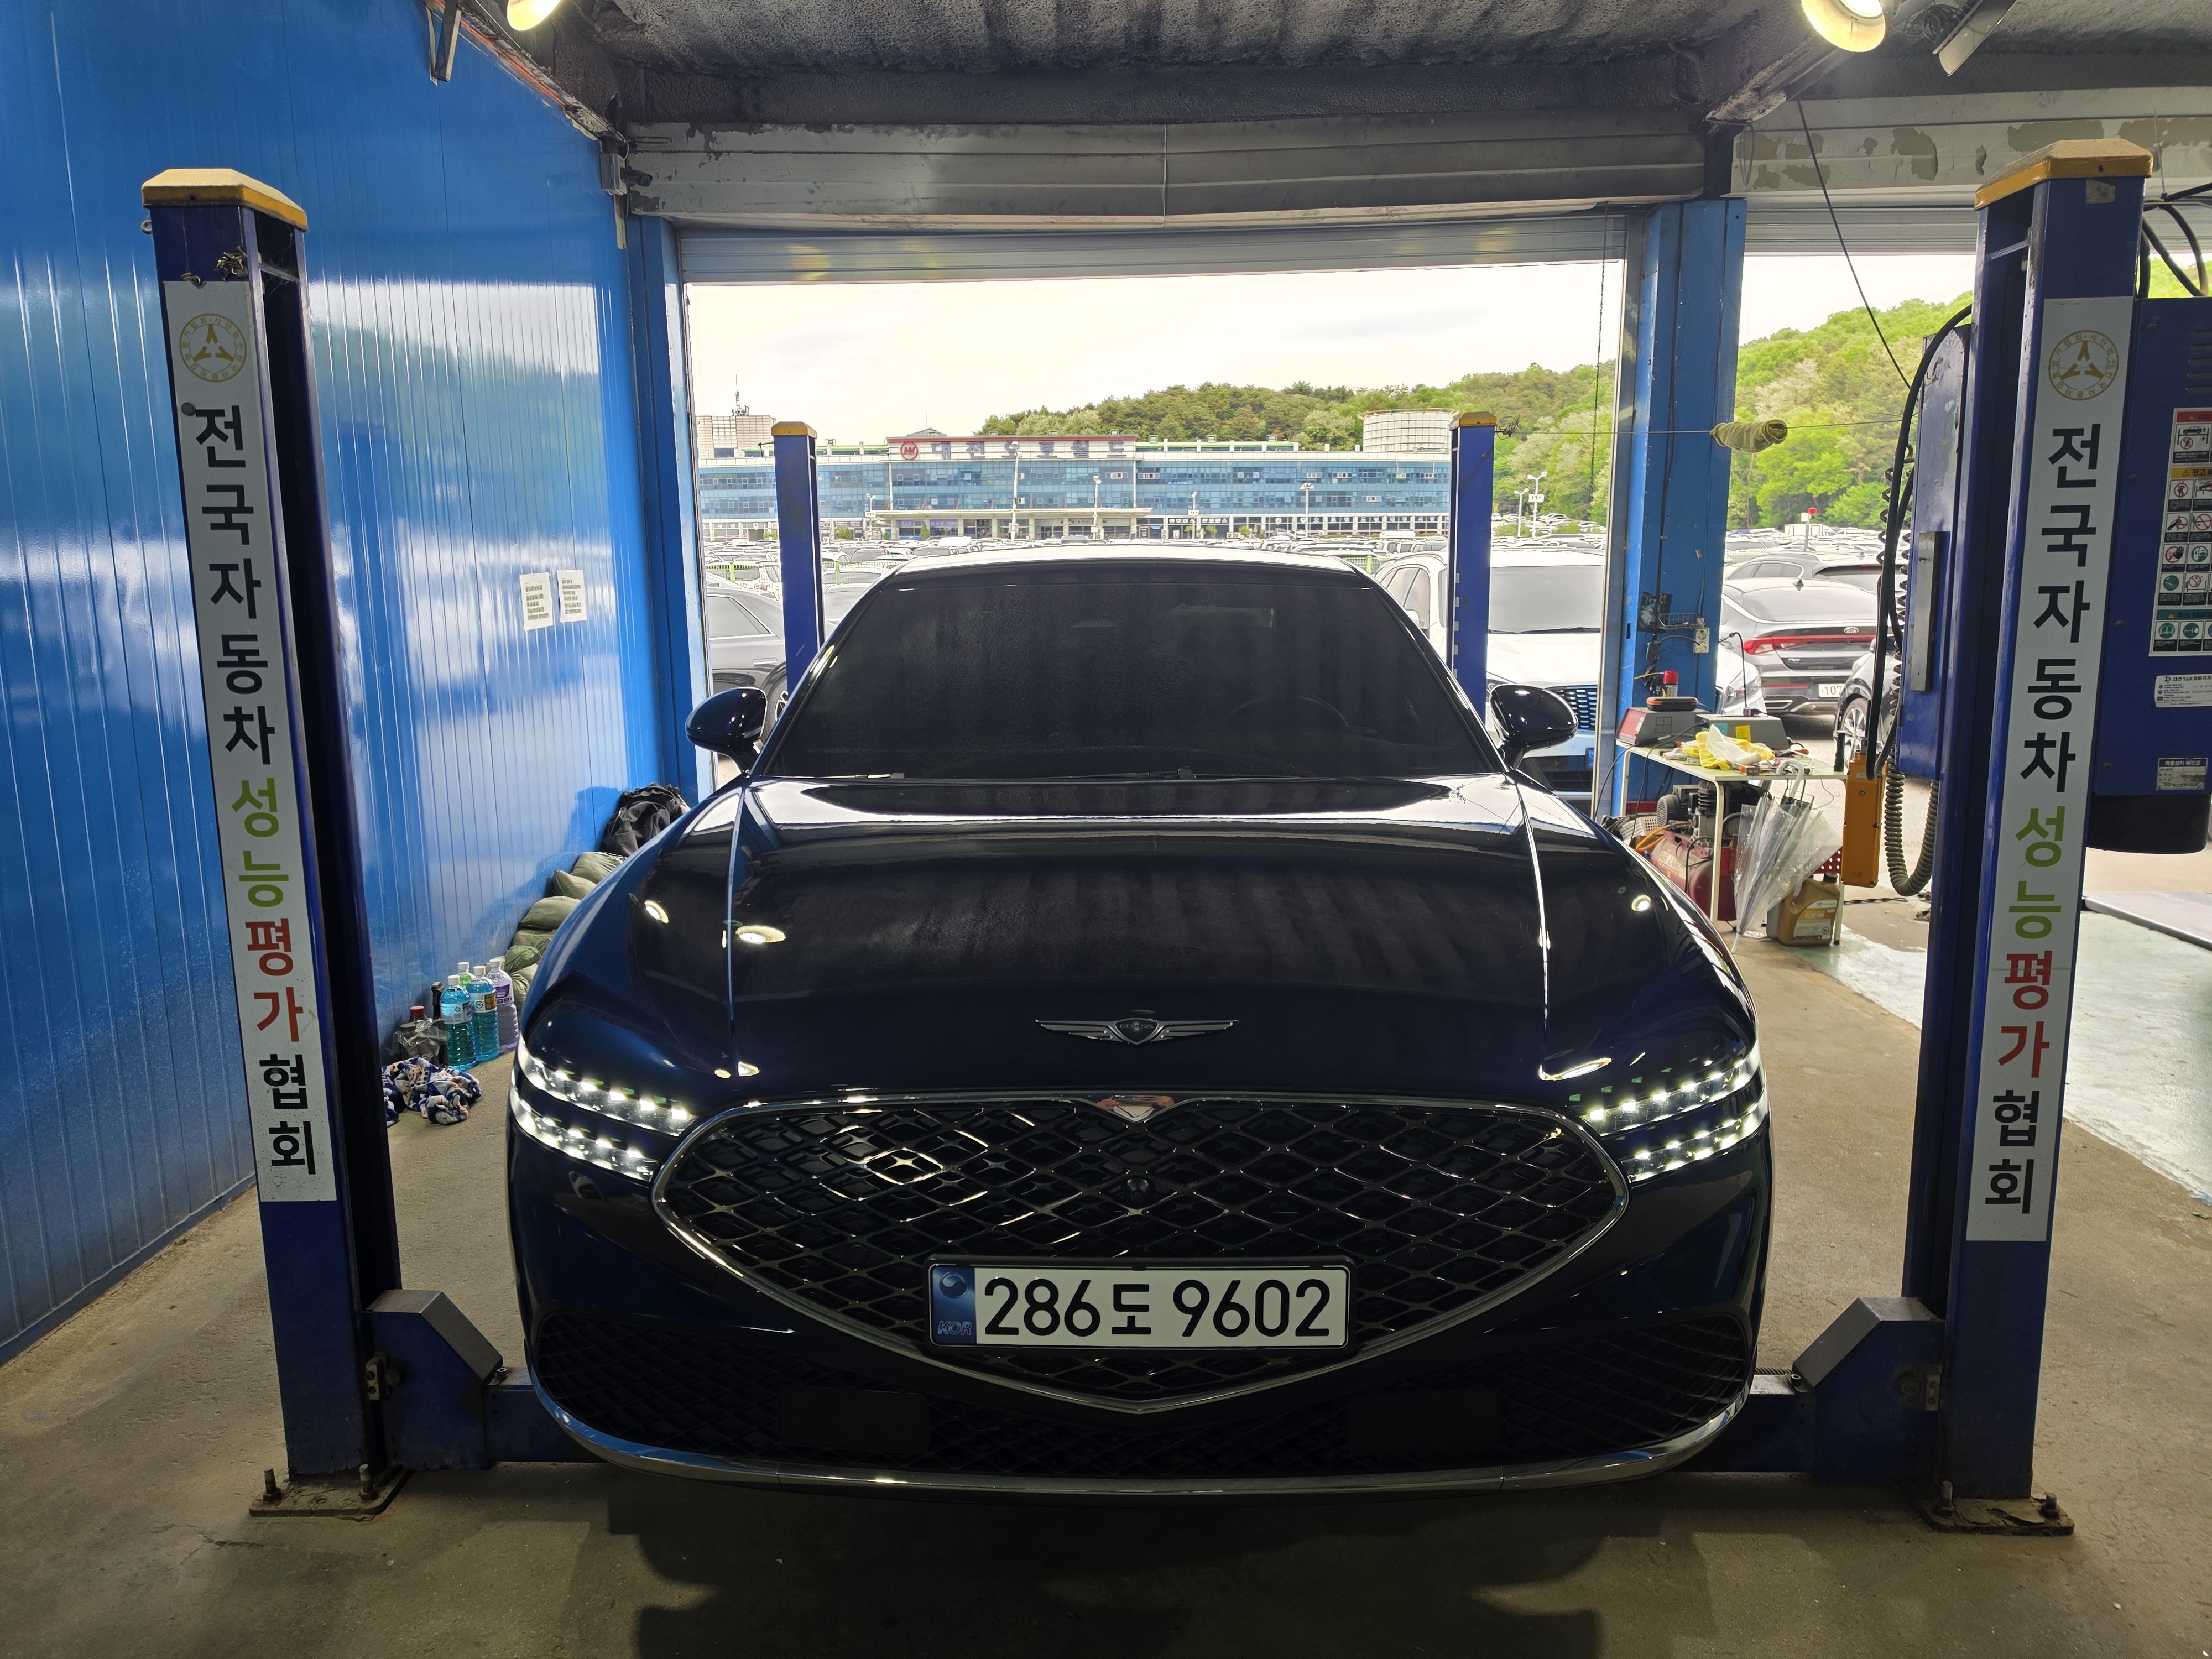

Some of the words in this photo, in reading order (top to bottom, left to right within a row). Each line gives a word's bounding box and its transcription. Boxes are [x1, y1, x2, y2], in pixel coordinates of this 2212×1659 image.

[984, 1277, 1152, 1337] 286도
[1172, 1279, 1331, 1337] 9602
[937, 1320, 972, 1335] KOR
